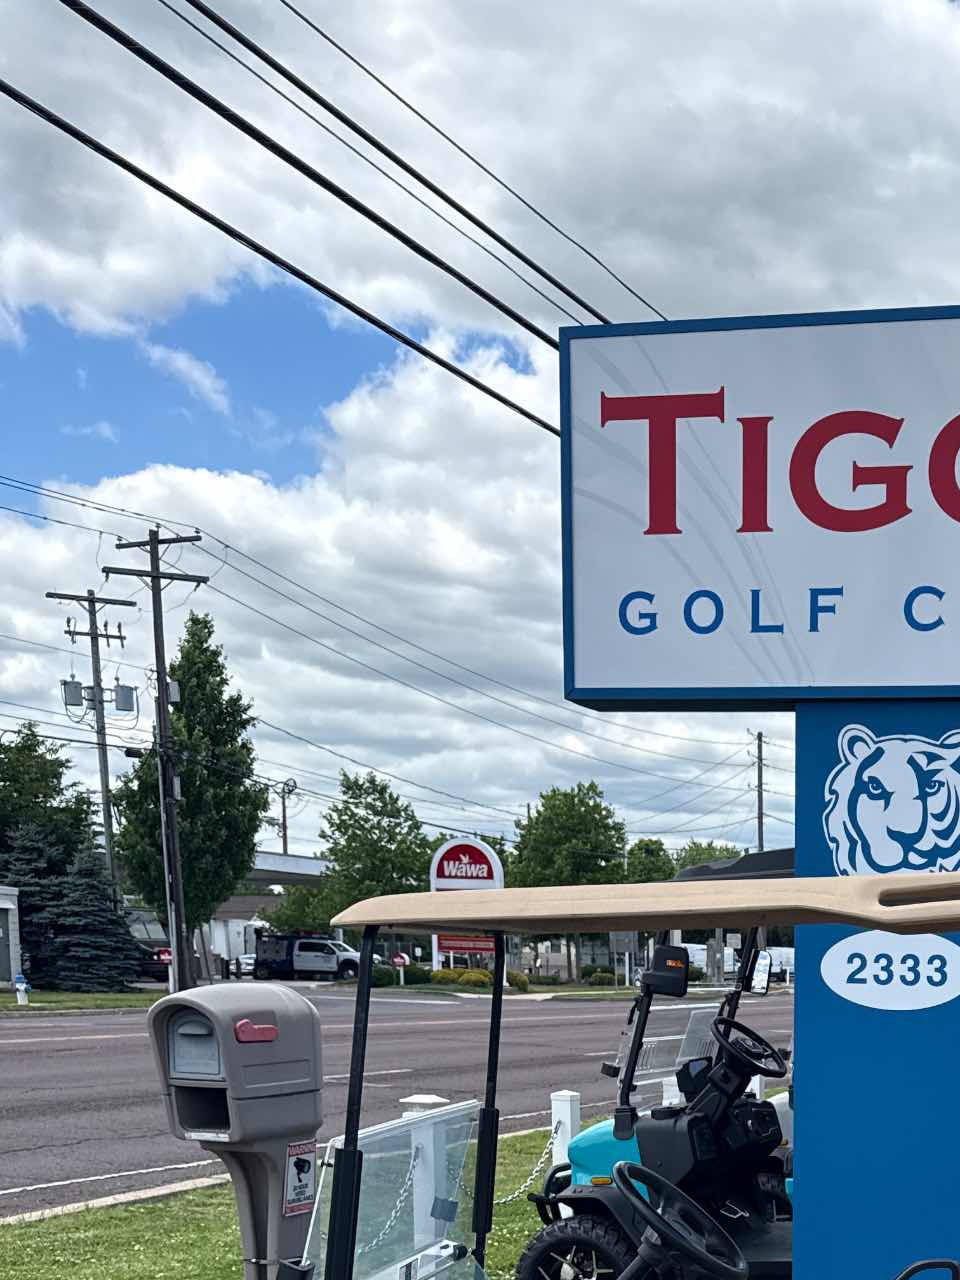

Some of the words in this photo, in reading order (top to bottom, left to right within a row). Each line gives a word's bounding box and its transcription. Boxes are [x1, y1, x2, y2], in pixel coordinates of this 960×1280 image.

[618, 584, 844, 636] GOLF
[443, 860, 488, 877] Wawa
[845, 953, 949, 988] 2333
